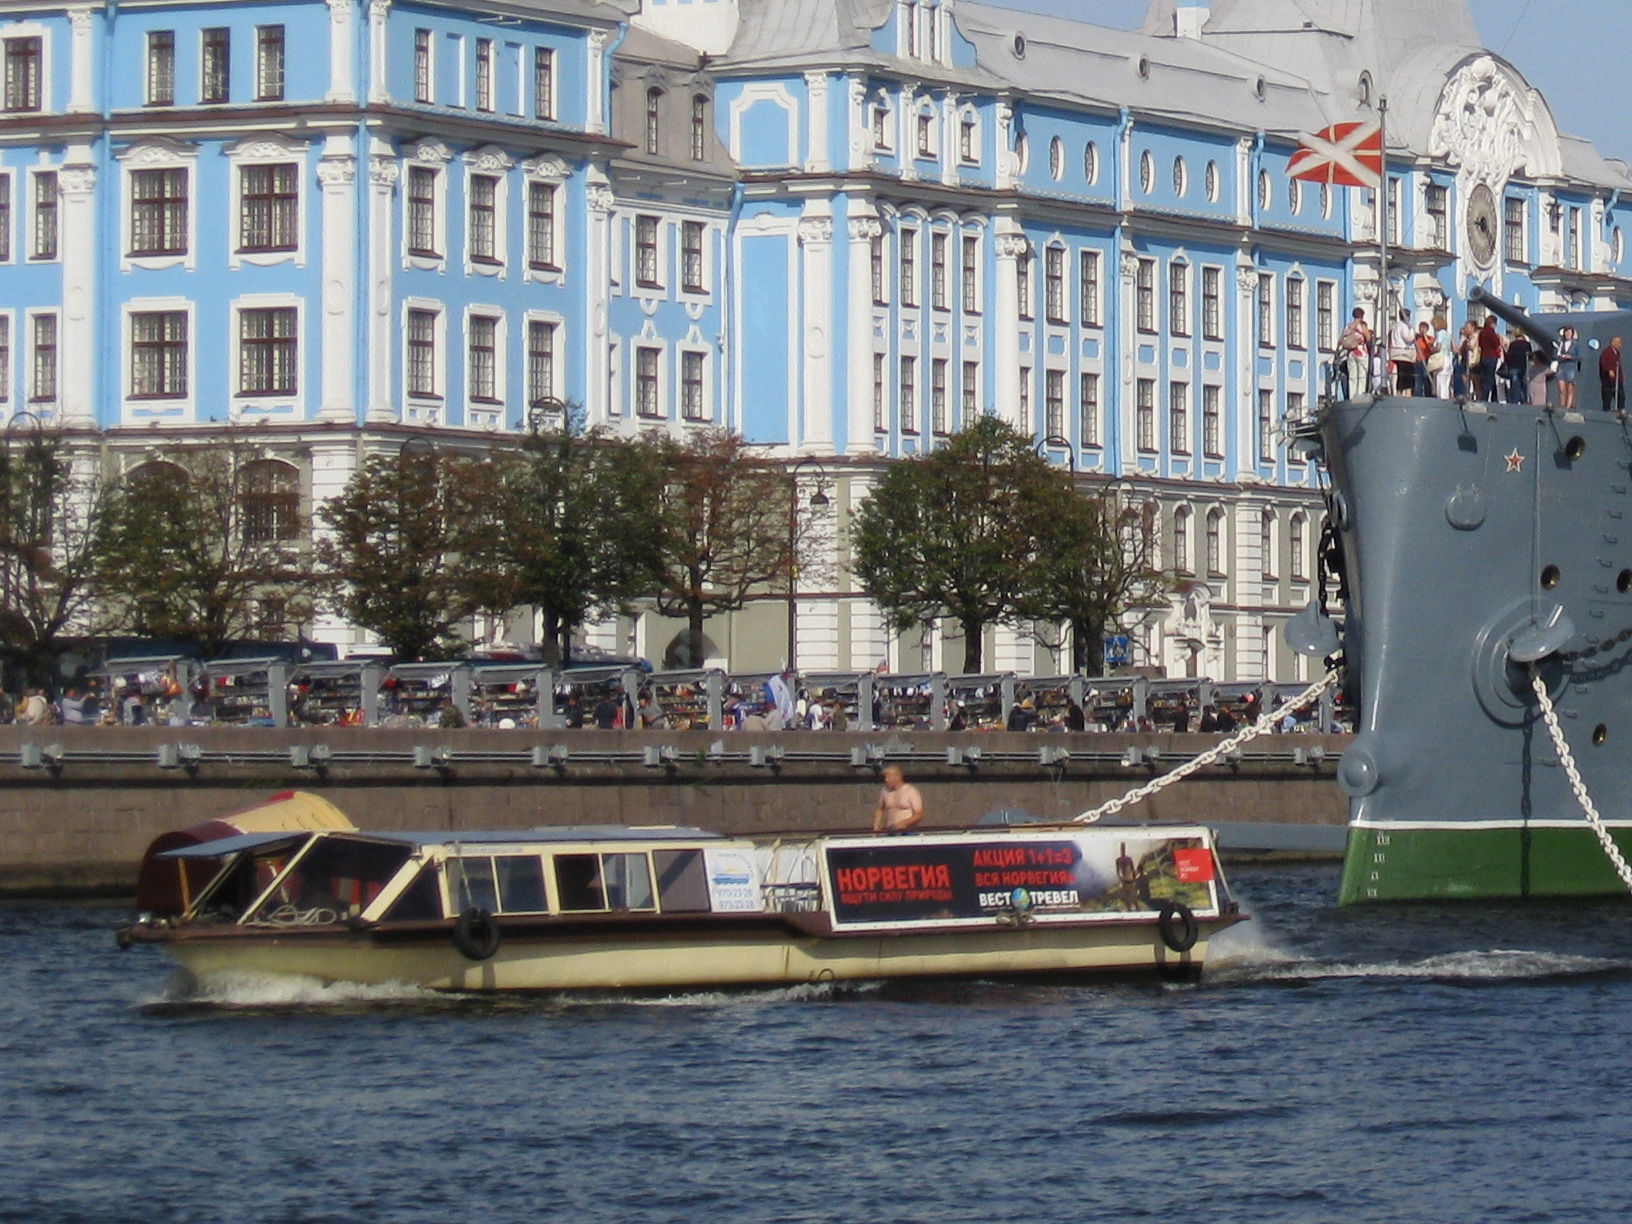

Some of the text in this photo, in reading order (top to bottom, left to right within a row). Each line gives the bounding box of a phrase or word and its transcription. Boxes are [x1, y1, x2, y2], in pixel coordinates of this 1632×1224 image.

[974, 848, 1026, 867] АКЦИЯ
[837, 864, 950, 891] НОРВЕГИЯ
[975, 872, 1000, 887] ВСЯ
[979, 890, 1079, 907] ВЕСТ ТРЕВЕЛ
